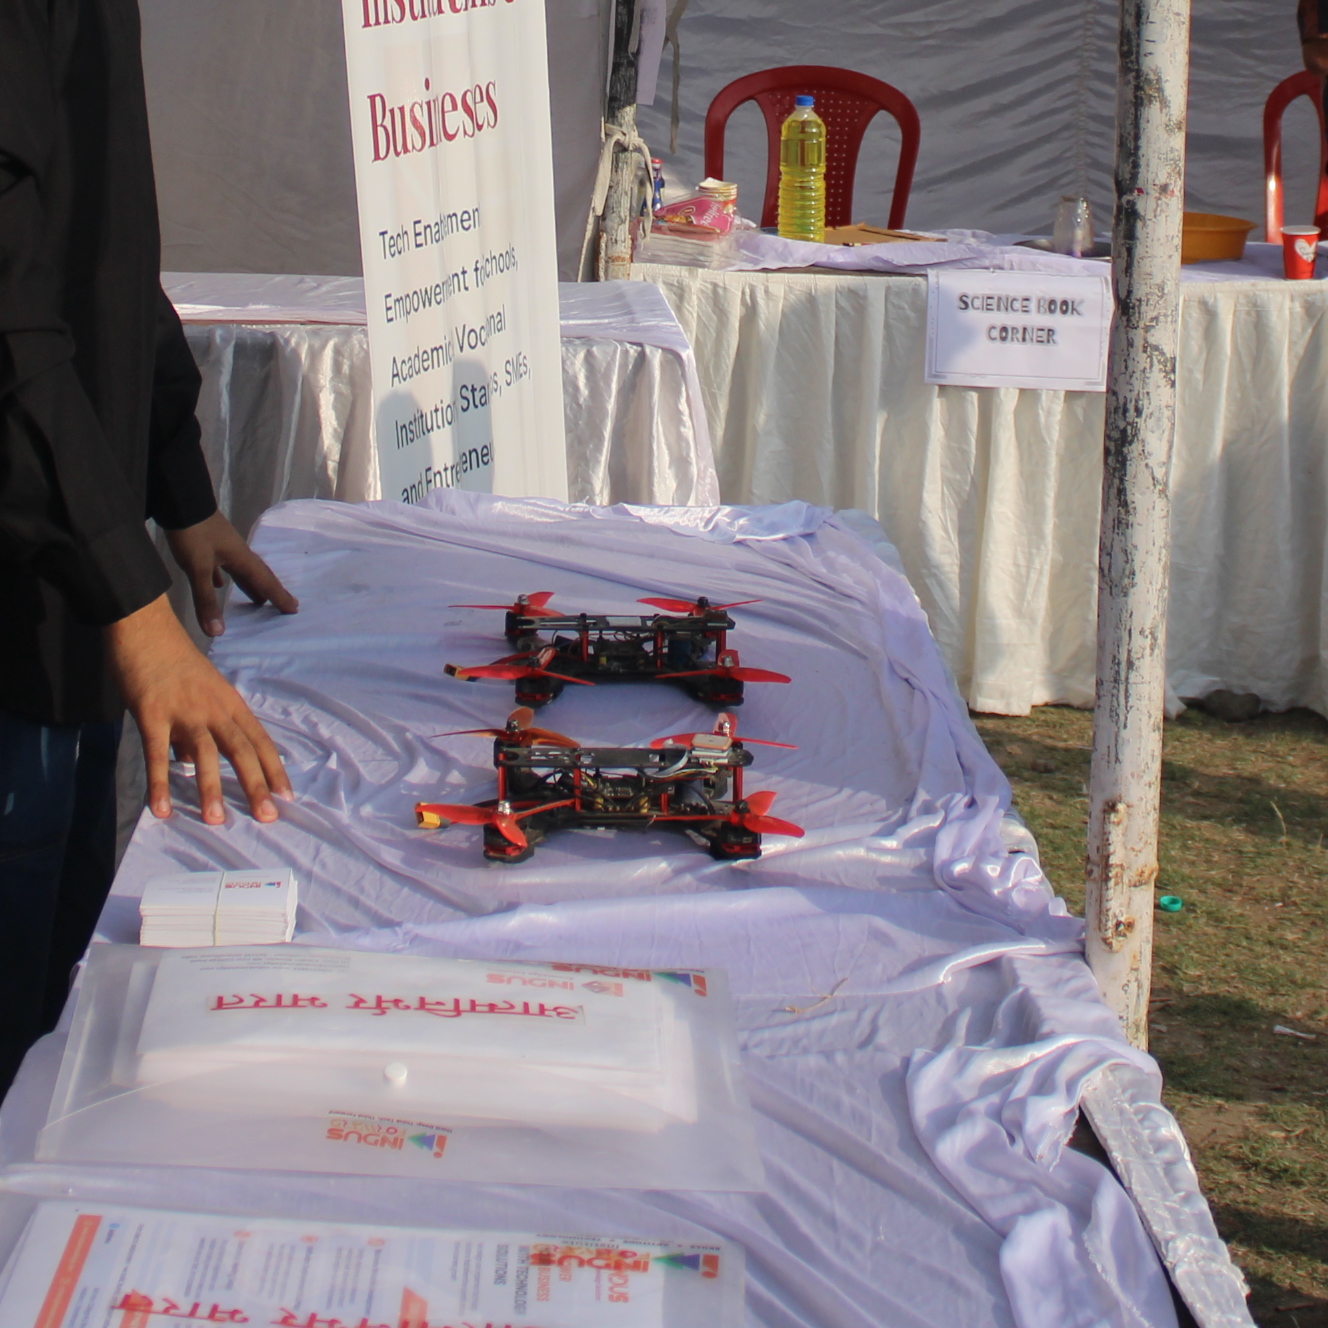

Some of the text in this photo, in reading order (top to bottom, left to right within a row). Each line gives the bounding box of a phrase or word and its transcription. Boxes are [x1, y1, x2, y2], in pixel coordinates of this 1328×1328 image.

[379, 224, 410, 260] Tech
[958, 294, 1084, 316] SCIENCE BOOK
[987, 325, 1057, 344] CORNER
[486, 973, 574, 991] INDUS
[210, 994, 577, 1019] आत्मनिर्भर भारत
[326, 1127, 404, 1150] INDUS
[530, 1253, 649, 1272] INDUS
[608, 1270, 630, 1304] NDUS
